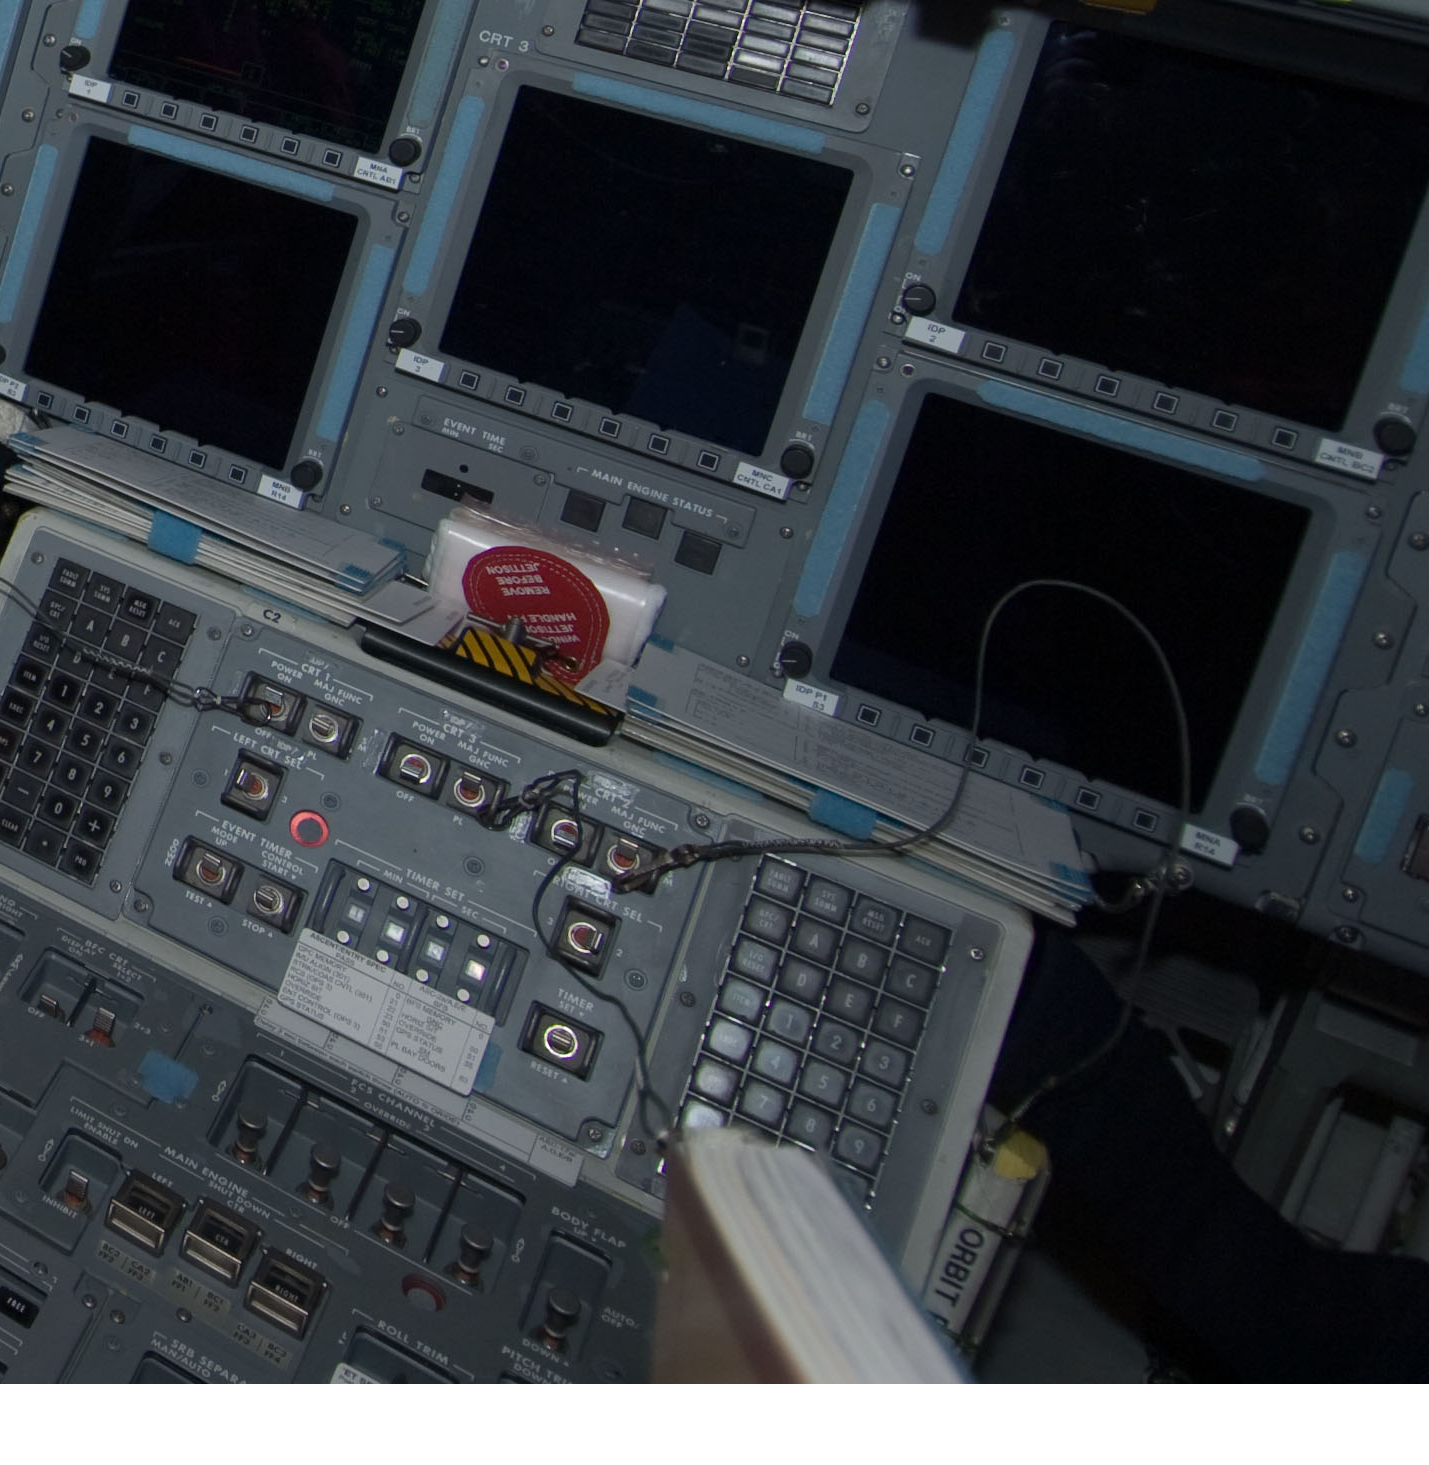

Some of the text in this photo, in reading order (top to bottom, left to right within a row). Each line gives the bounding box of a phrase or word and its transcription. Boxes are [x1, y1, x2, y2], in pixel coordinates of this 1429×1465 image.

[478, 29, 515, 50] CRT
[444, 417, 506, 446] EVENT TIME
[591, 468, 713, 517] MAIN ENGINE STATUS
[486, 562, 541, 575] JETTISON
[497, 574, 543, 585] BEFORE
[502, 585, 550, 596] REMOVE
[263, 608, 282, 623] C2
[301, 663, 324, 678] CRT
[271, 660, 363, 705] POWER MAJ FUNC
[324, 692, 345, 707] GNC
[443, 723, 466, 739] CRT
[233, 732, 257, 750] LEFT
[457, 740, 510, 768] MAJ FUNC
[468, 755, 490, 770] GNC
[396, 790, 414, 803] OFF
[215, 837, 228, 848] UP
[221, 820, 293, 859] EVENT TIMER
[211, 826, 304, 876] MODE CONTROL
[262, 860, 288, 876] START
[383, 870, 478, 919] MIN SEC
[406, 869, 465, 902] TIMER SET
[185, 891, 205, 905] TEST
[623, 907, 643, 923] SEL
[242, 919, 265, 935] STOP
[557, 988, 594, 1012] TIMER
[530, 1062, 559, 1079] RESET
[70, 1106, 94, 1123] LIMIT
[378, 1092, 436, 1128] CHANNEL
[164, 1146, 249, 1198] MAIN ENGINE
[42, 1195, 78, 1219] INHIBIT
[551, 1206, 588, 1228] BODY
[284, 1247, 318, 1271] RIGHT
[935, 1229, 984, 1308] ORBIT
[377, 1319, 450, 1366] ROLL TRIM
